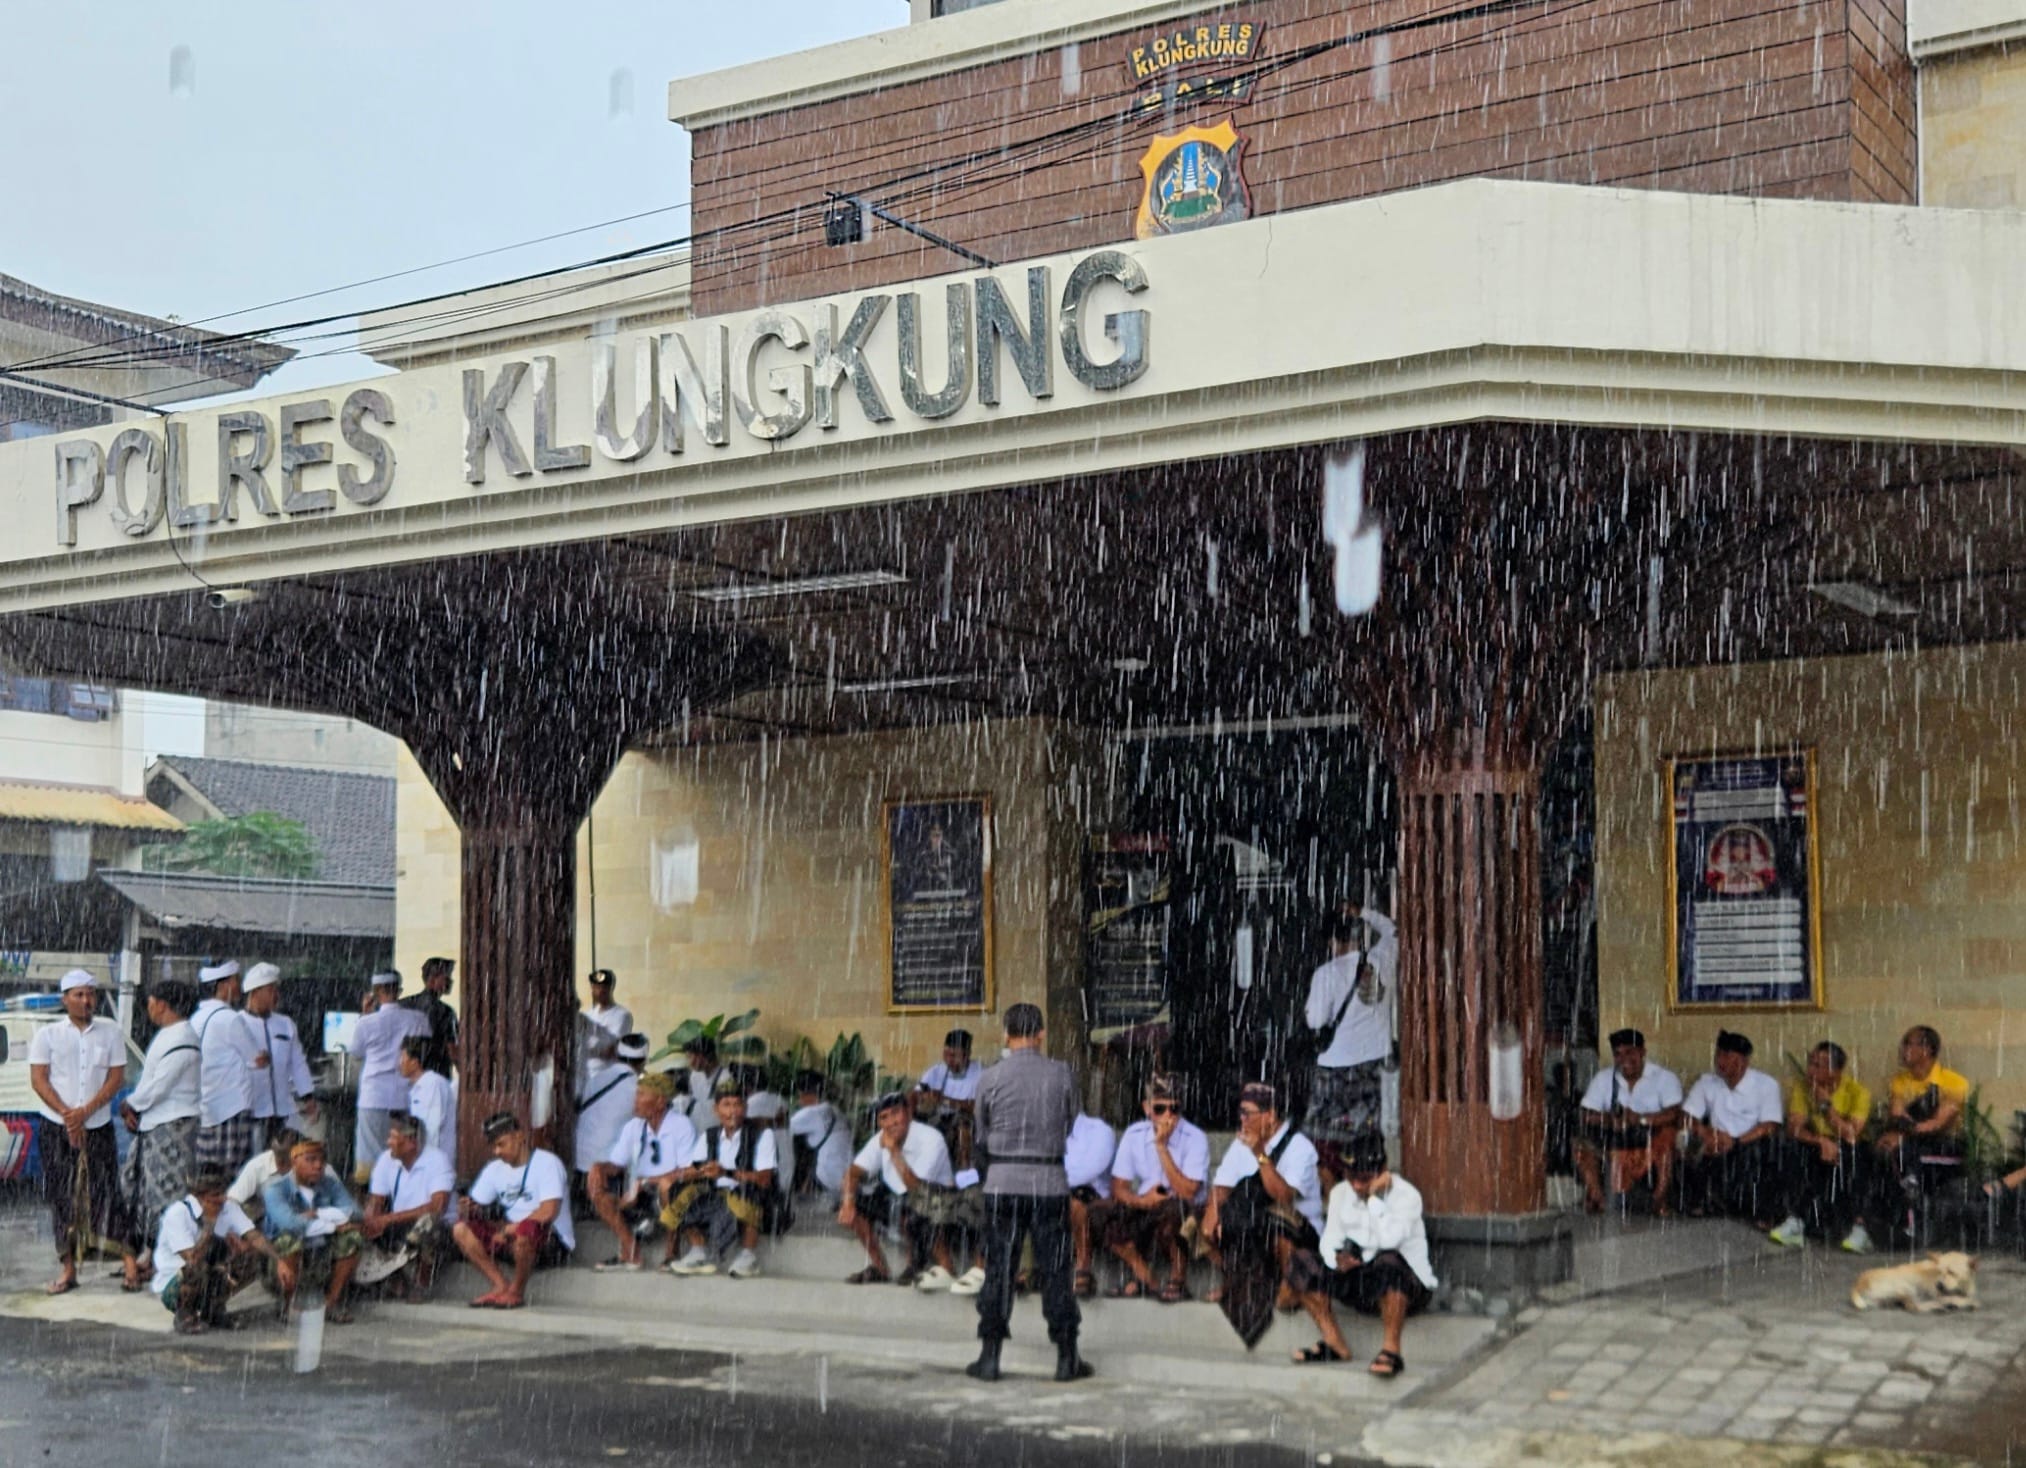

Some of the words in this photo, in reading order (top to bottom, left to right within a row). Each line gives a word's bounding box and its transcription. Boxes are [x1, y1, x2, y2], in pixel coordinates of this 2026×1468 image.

[1132, 24, 1252, 63] POLRES
[1135, 39, 1249, 78] KLUNGKUNG
[55, 388, 396, 546] POLRES
[461, 250, 1151, 485] KLUNGKUNG
